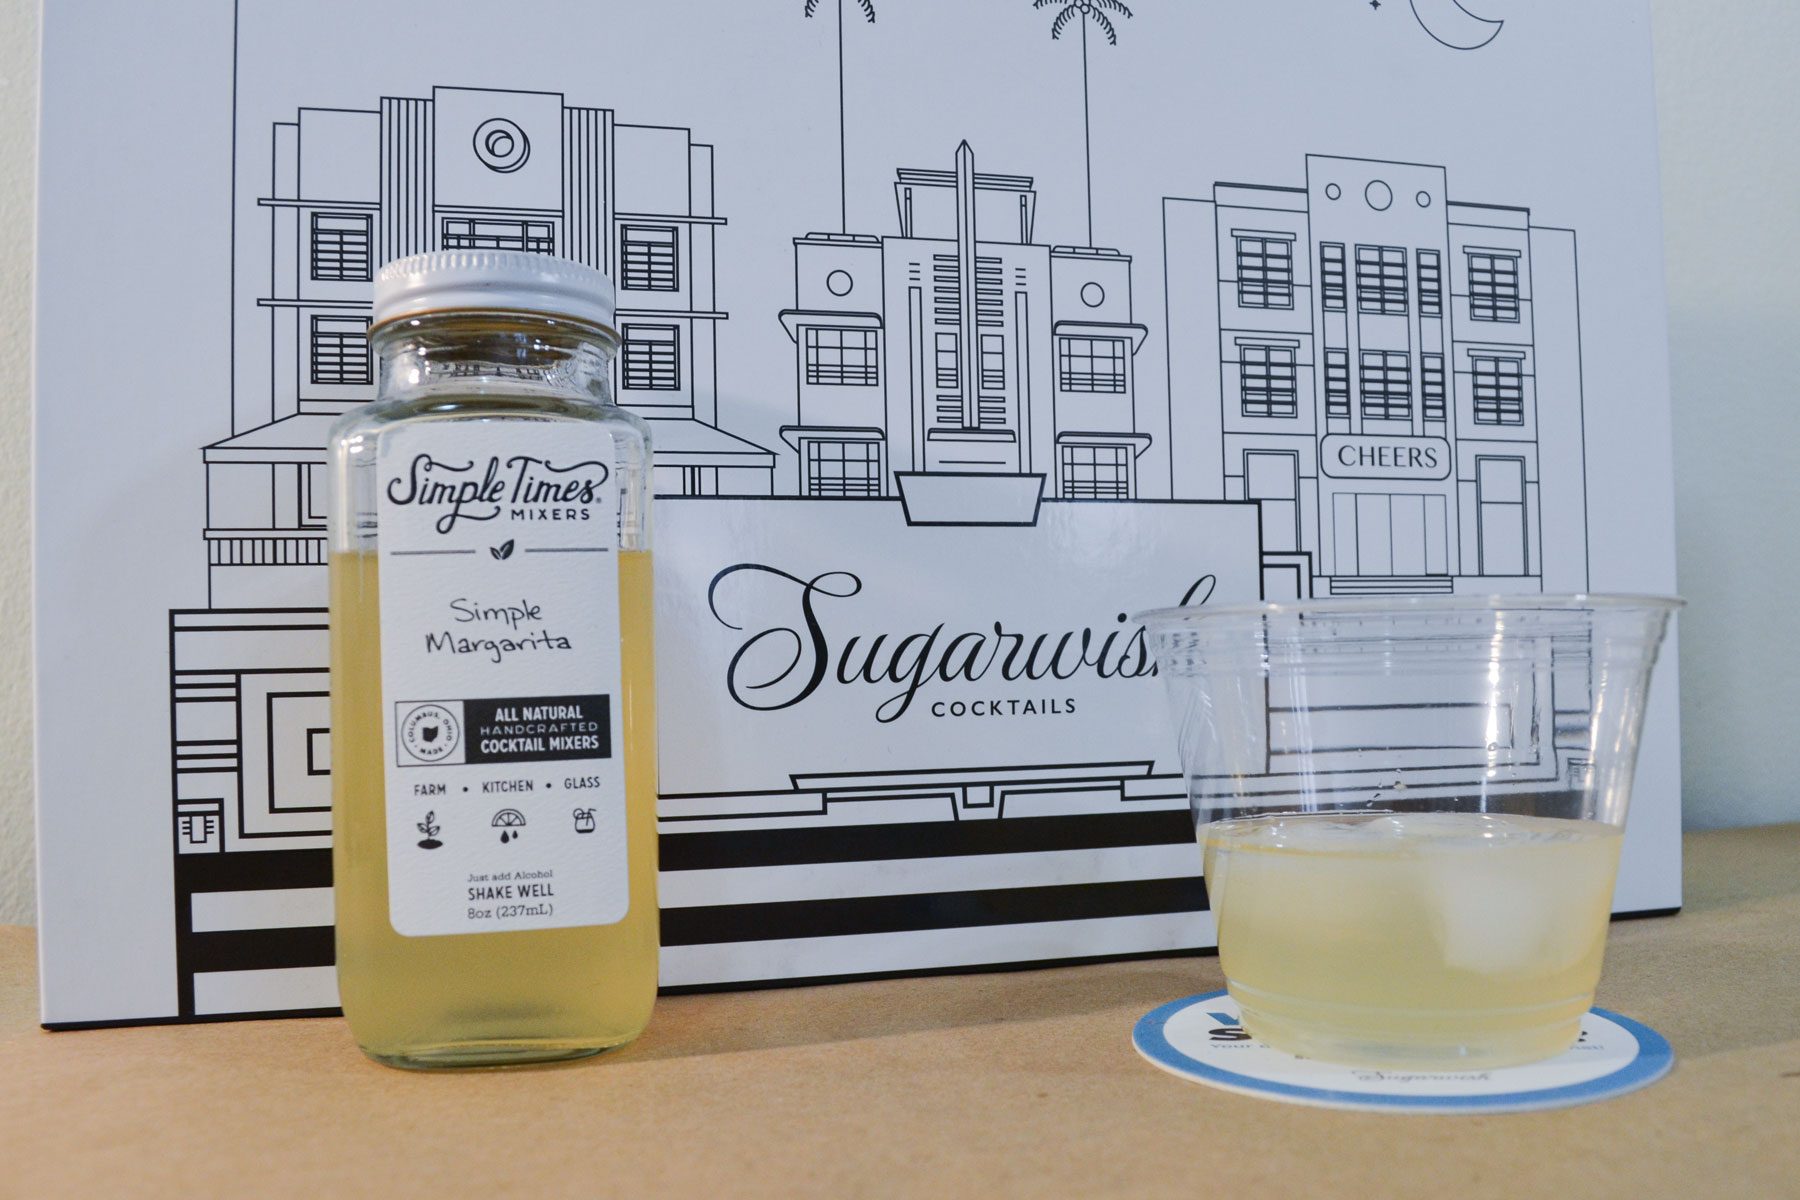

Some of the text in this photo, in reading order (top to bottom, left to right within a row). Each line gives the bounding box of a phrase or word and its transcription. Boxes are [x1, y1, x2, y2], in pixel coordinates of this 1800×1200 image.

[1338, 444, 1438, 469] CHEERS
[387, 453, 609, 534] Simple Times
[511, 508, 591, 521] MIXERS
[450, 598, 544, 630] Simple
[425, 630, 573, 664] Margarita
[494, 705, 584, 722] ALL NATURAL
[931, 697, 1077, 719] COCKTAILS
[480, 721, 599, 736] HANDCRAFTED
[480, 735, 600, 754] COCKTAIL MIXERS
[414, 776, 601, 796] FARM KITCHEN GLASS
[467, 869, 554, 883] Just add Alcohol
[467, 883, 555, 901] SHAKE WELL
[467, 903, 554, 920] 8oz (237mL)
